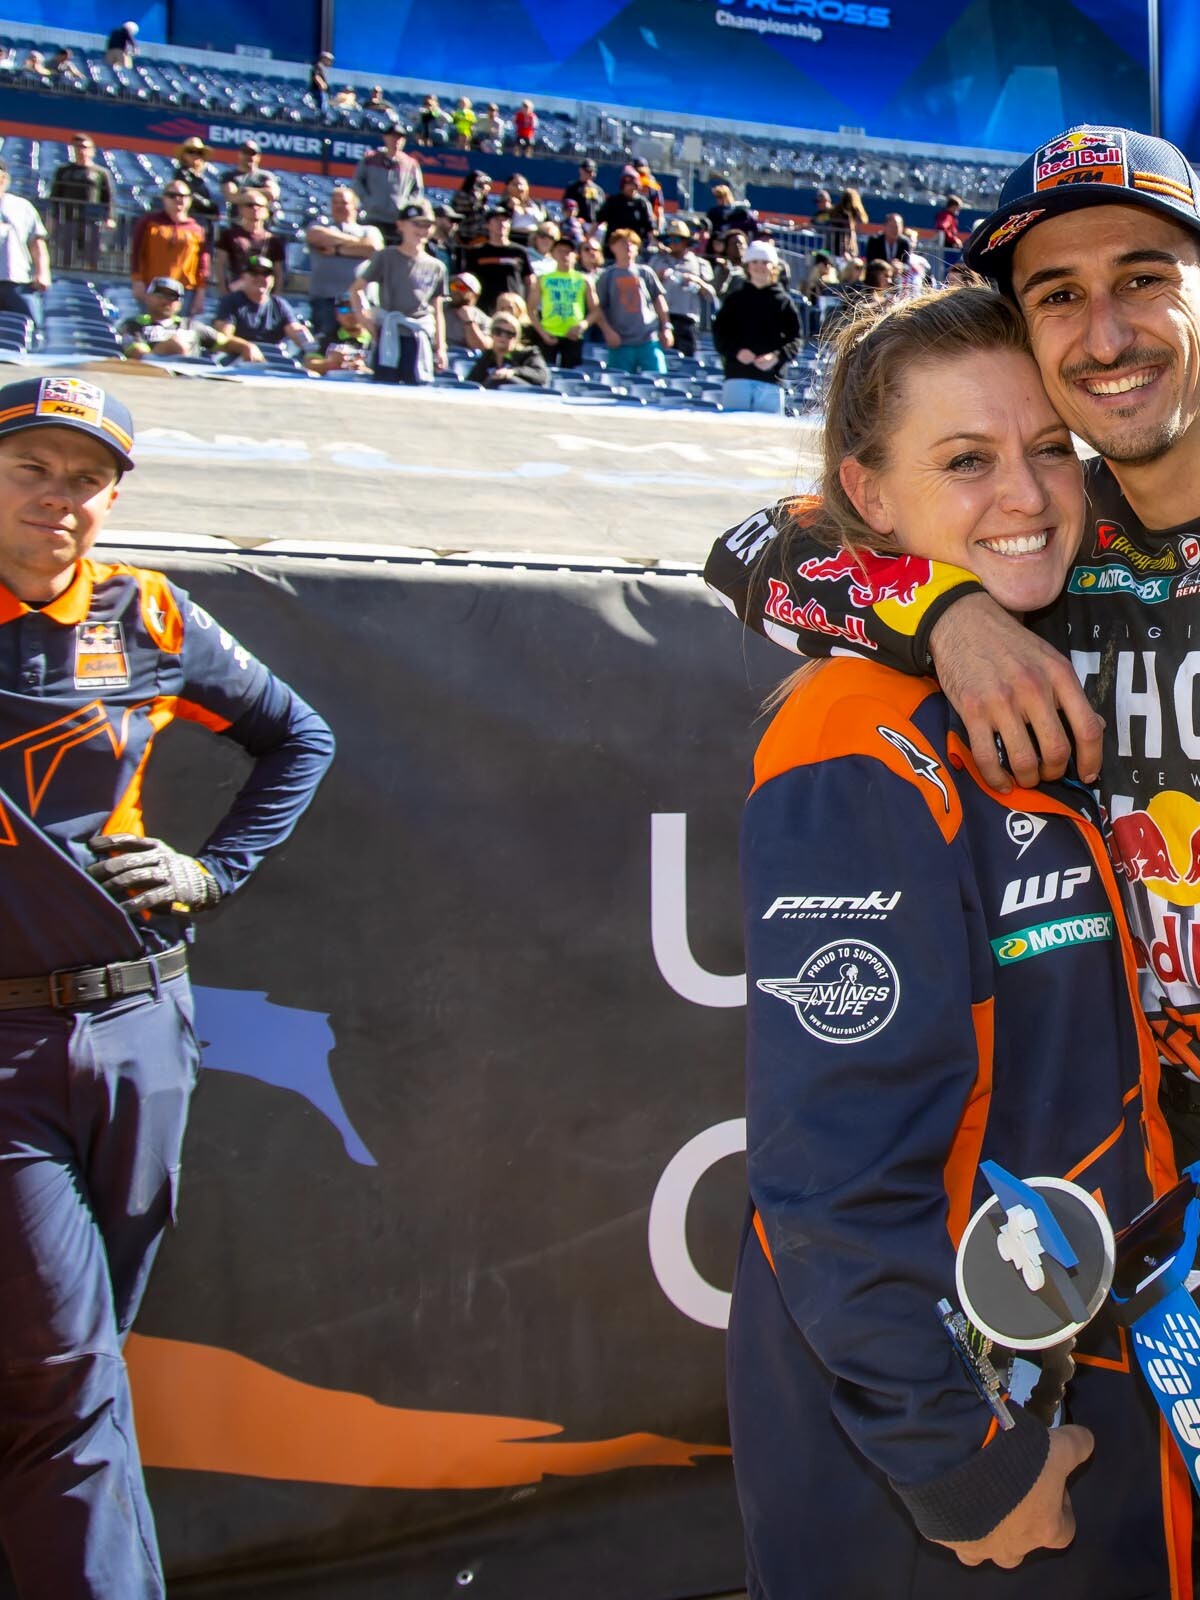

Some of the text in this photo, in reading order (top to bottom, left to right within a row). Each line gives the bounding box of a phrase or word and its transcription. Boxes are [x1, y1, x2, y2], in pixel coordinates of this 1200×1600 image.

[715, 9, 823, 42] Championship
[208, 124, 322, 155] EMPOWER
[1038, 149, 1120, 179] Red Bull
[831, 912, 888, 920] SYSTEMS
[1028, 914, 1111, 952] MOTOREX
[807, 948, 889, 980] PROUD TO SUPPORT
[818, 981, 891, 1002] WINGS
[825, 1001, 868, 1016] LIFE
